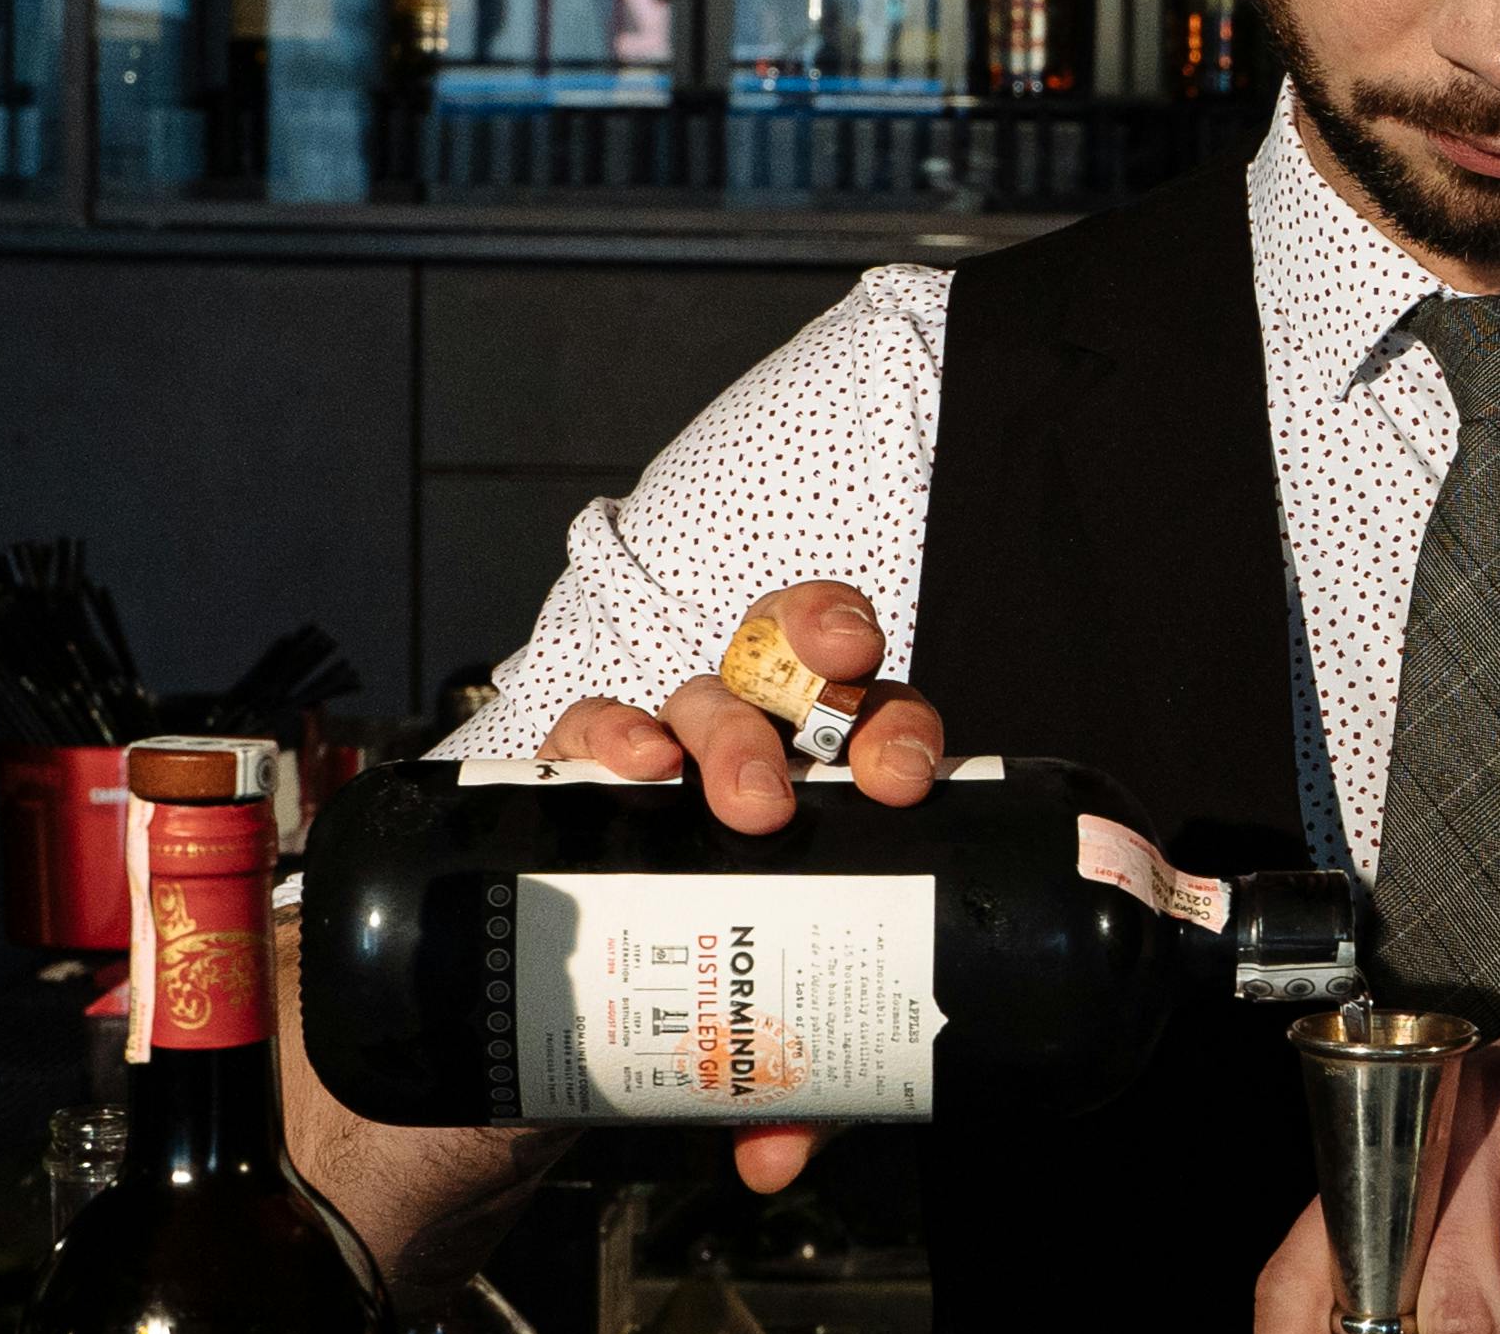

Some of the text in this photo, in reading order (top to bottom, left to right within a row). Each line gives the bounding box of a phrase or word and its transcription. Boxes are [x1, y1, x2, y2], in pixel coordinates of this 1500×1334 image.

[698, 935, 718, 1090] DISTILLED GIN
[731, 926, 755, 1097] NORMINDIA
[795, 982, 804, 1008] Lots
[844, 965, 853, 1024] botanical
[576, 1016, 586, 1062] DOMAINE
[795, 1016, 805, 1027] of
[908, 999, 919, 1044] APPLES
